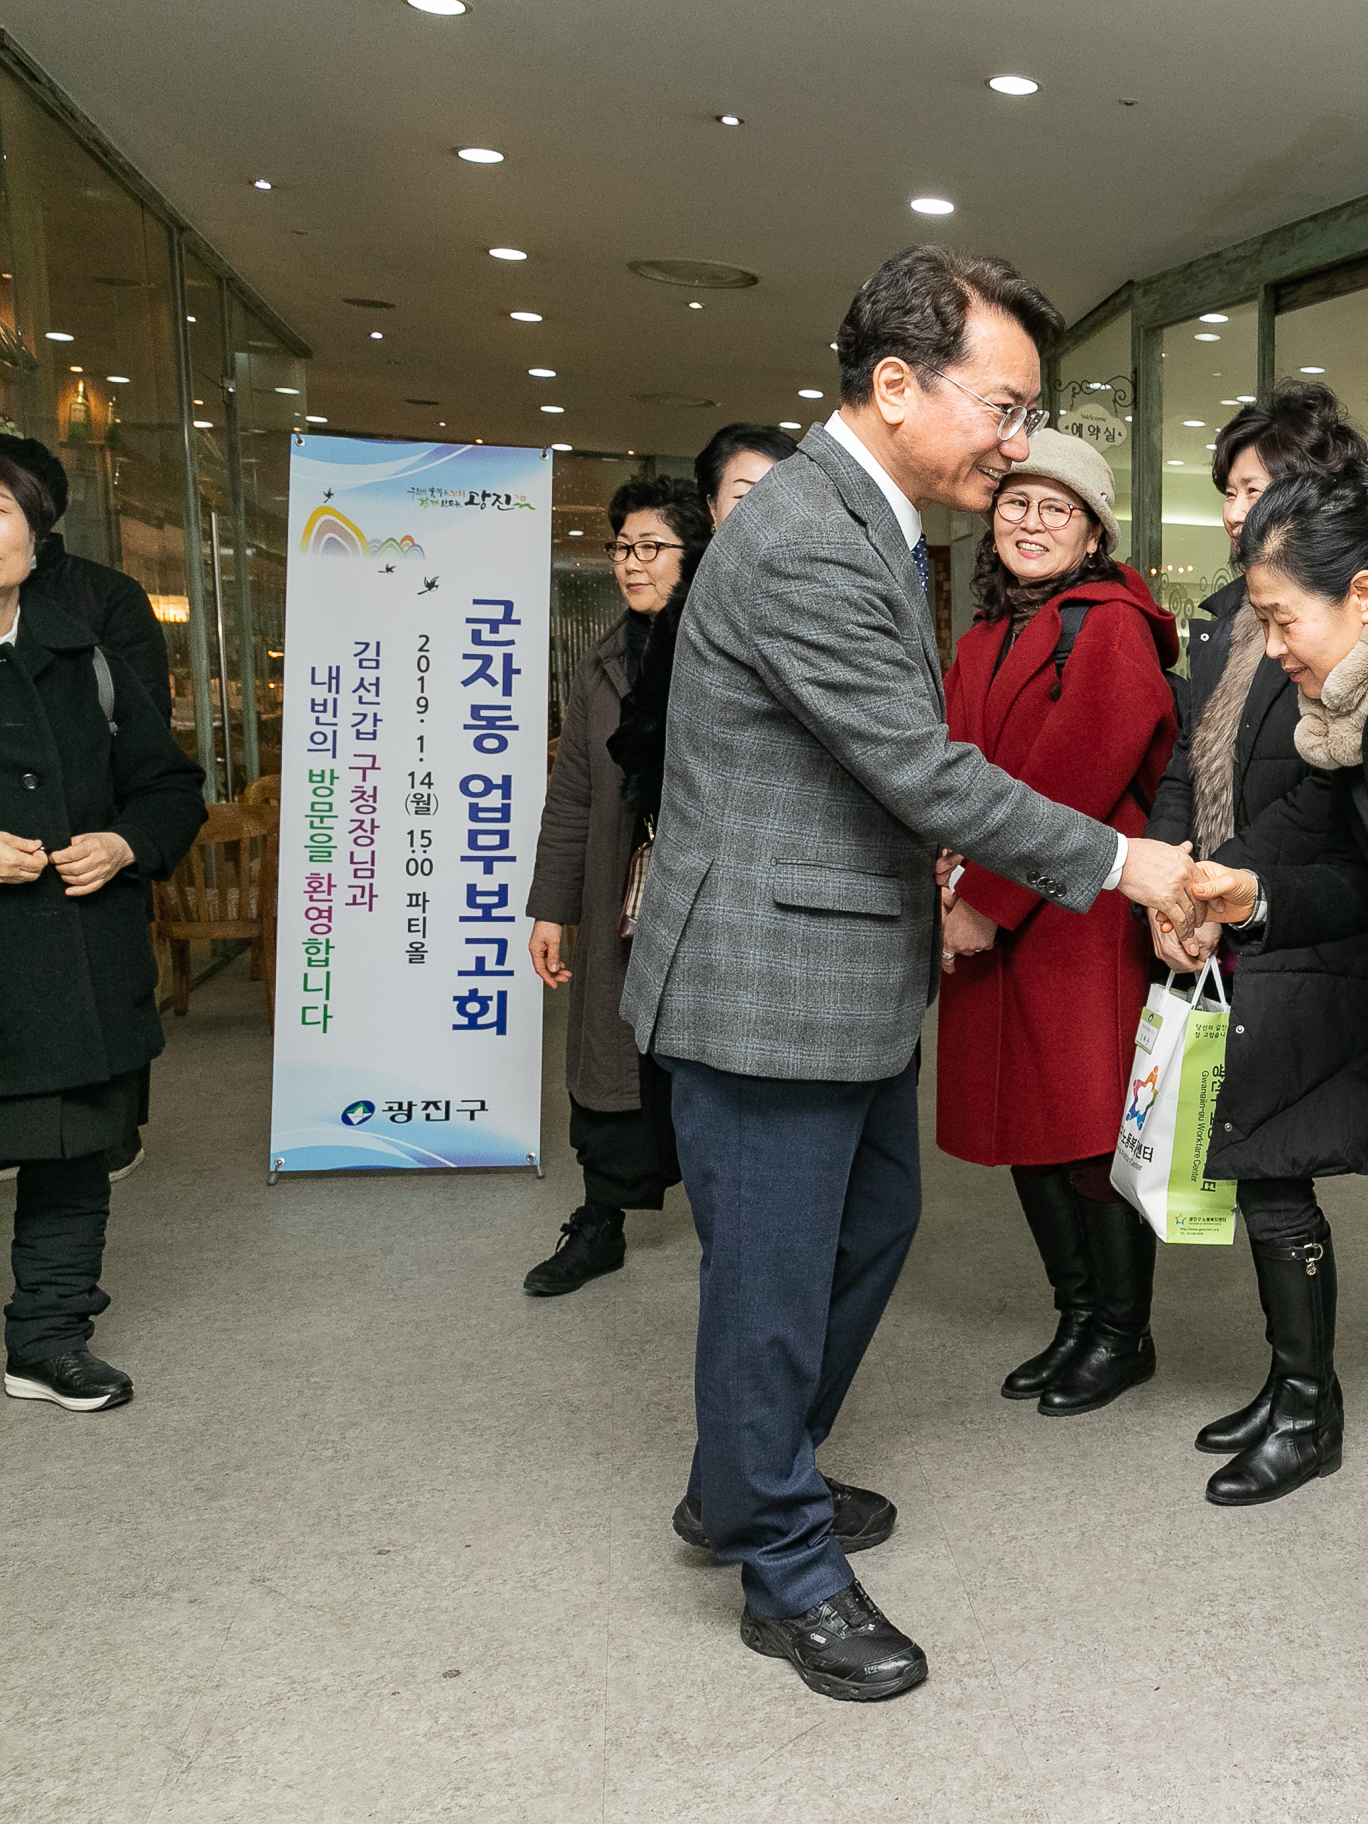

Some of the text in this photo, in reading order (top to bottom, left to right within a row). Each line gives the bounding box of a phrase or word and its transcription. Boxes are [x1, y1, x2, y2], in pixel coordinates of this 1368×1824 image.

[1071, 422, 1115, 443] 예약실
[464, 489, 515, 511] 광진
[344, 641, 383, 913] 김선갑 구청장님과
[301, 665, 341, 1035] 내빈의 방문을 환영합니다
[452, 599, 522, 1036] 군자동 업무보고회
[404, 891, 430, 965] 파티올
[381, 1099, 489, 1124] 광진구
